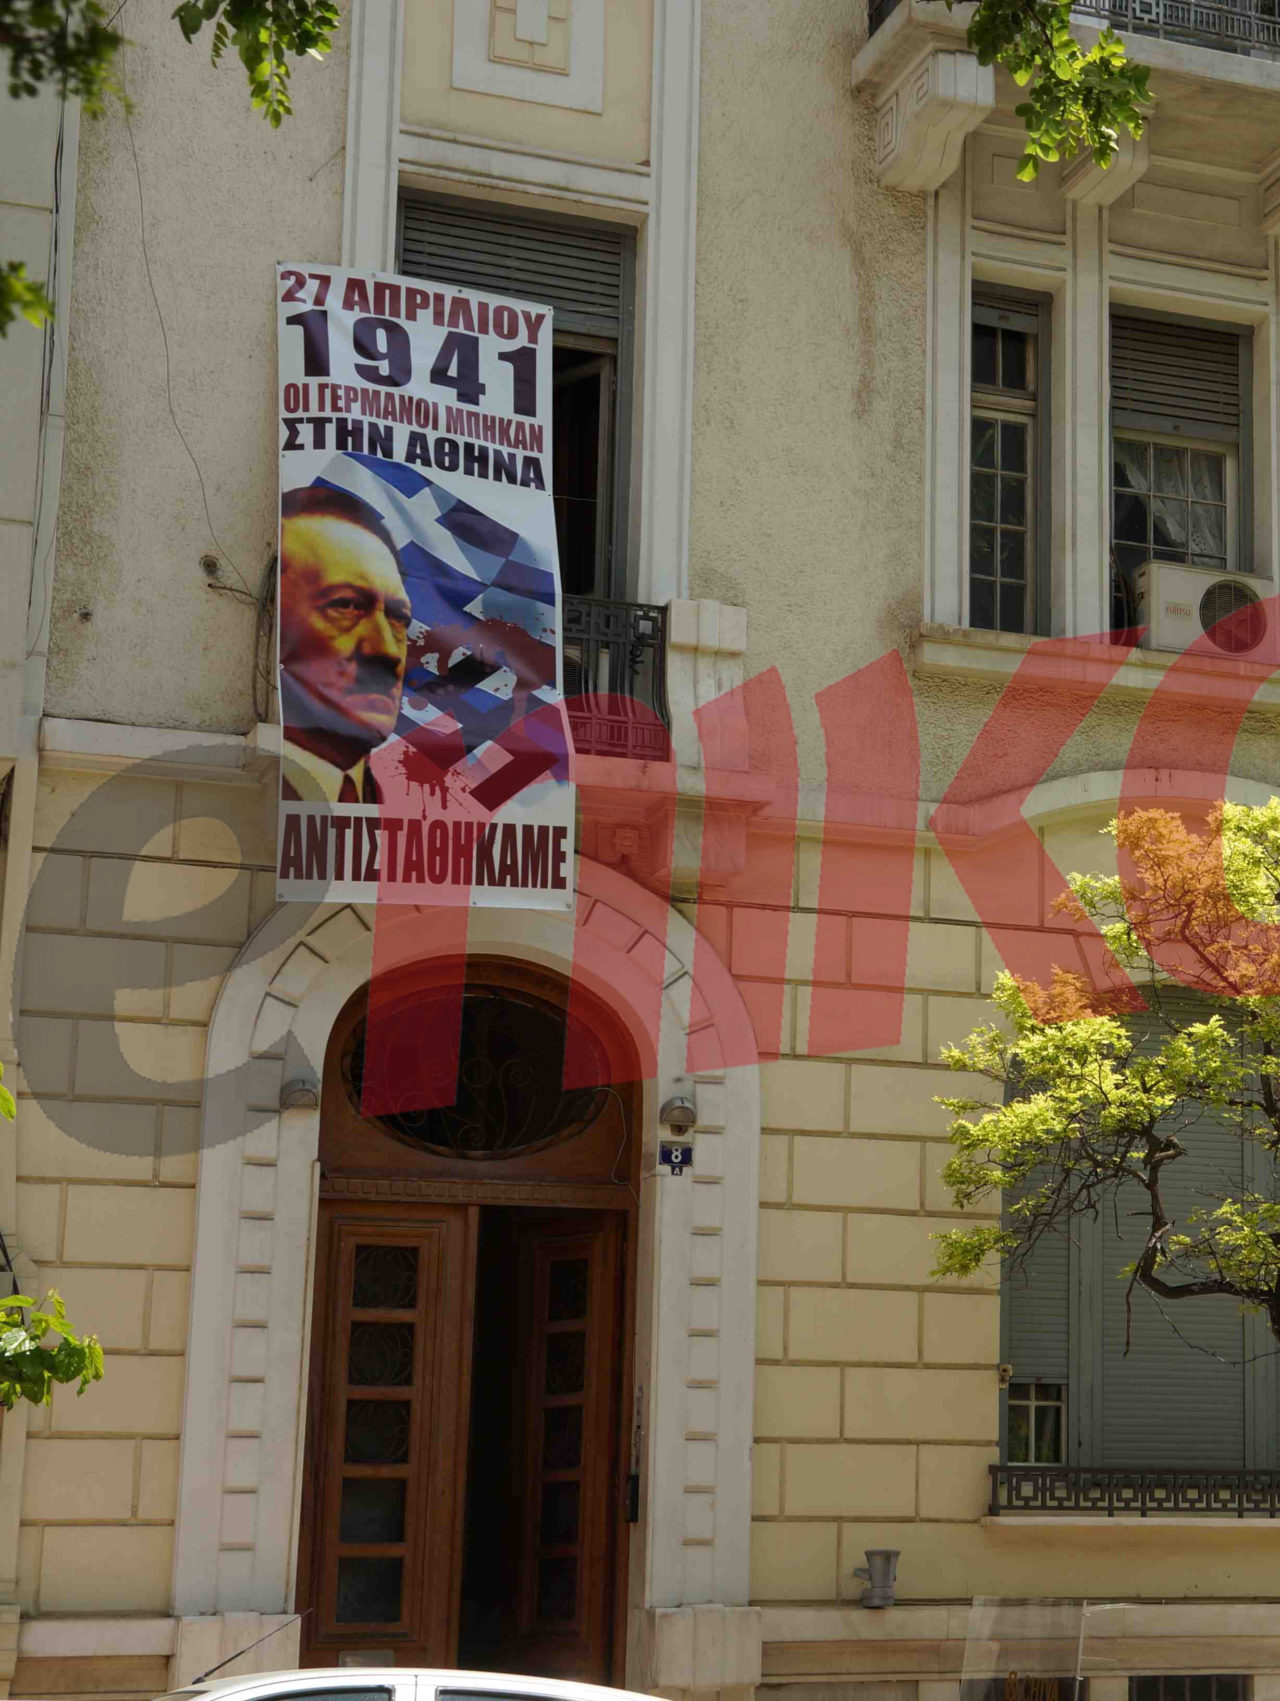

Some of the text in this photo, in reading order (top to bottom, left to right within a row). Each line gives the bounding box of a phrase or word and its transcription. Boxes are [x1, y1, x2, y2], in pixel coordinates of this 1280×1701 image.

[280, 270, 546, 345] 27 ΑΠΡΙΛΙΟΥ
[286, 309, 537, 418] 1941
[281, 416, 546, 491] ΣΤΗΝ ΑΘΗΝΑ
[283, 382, 543, 454] ΟΙ ΓΕΡΜΑΝΟΙ ΜΠΗΚΑΝ
[279, 813, 568, 890] ΑΝΤΙΣΤΑΘΗΚΑΜΕ
[671, 1146, 682, 1163] 8
